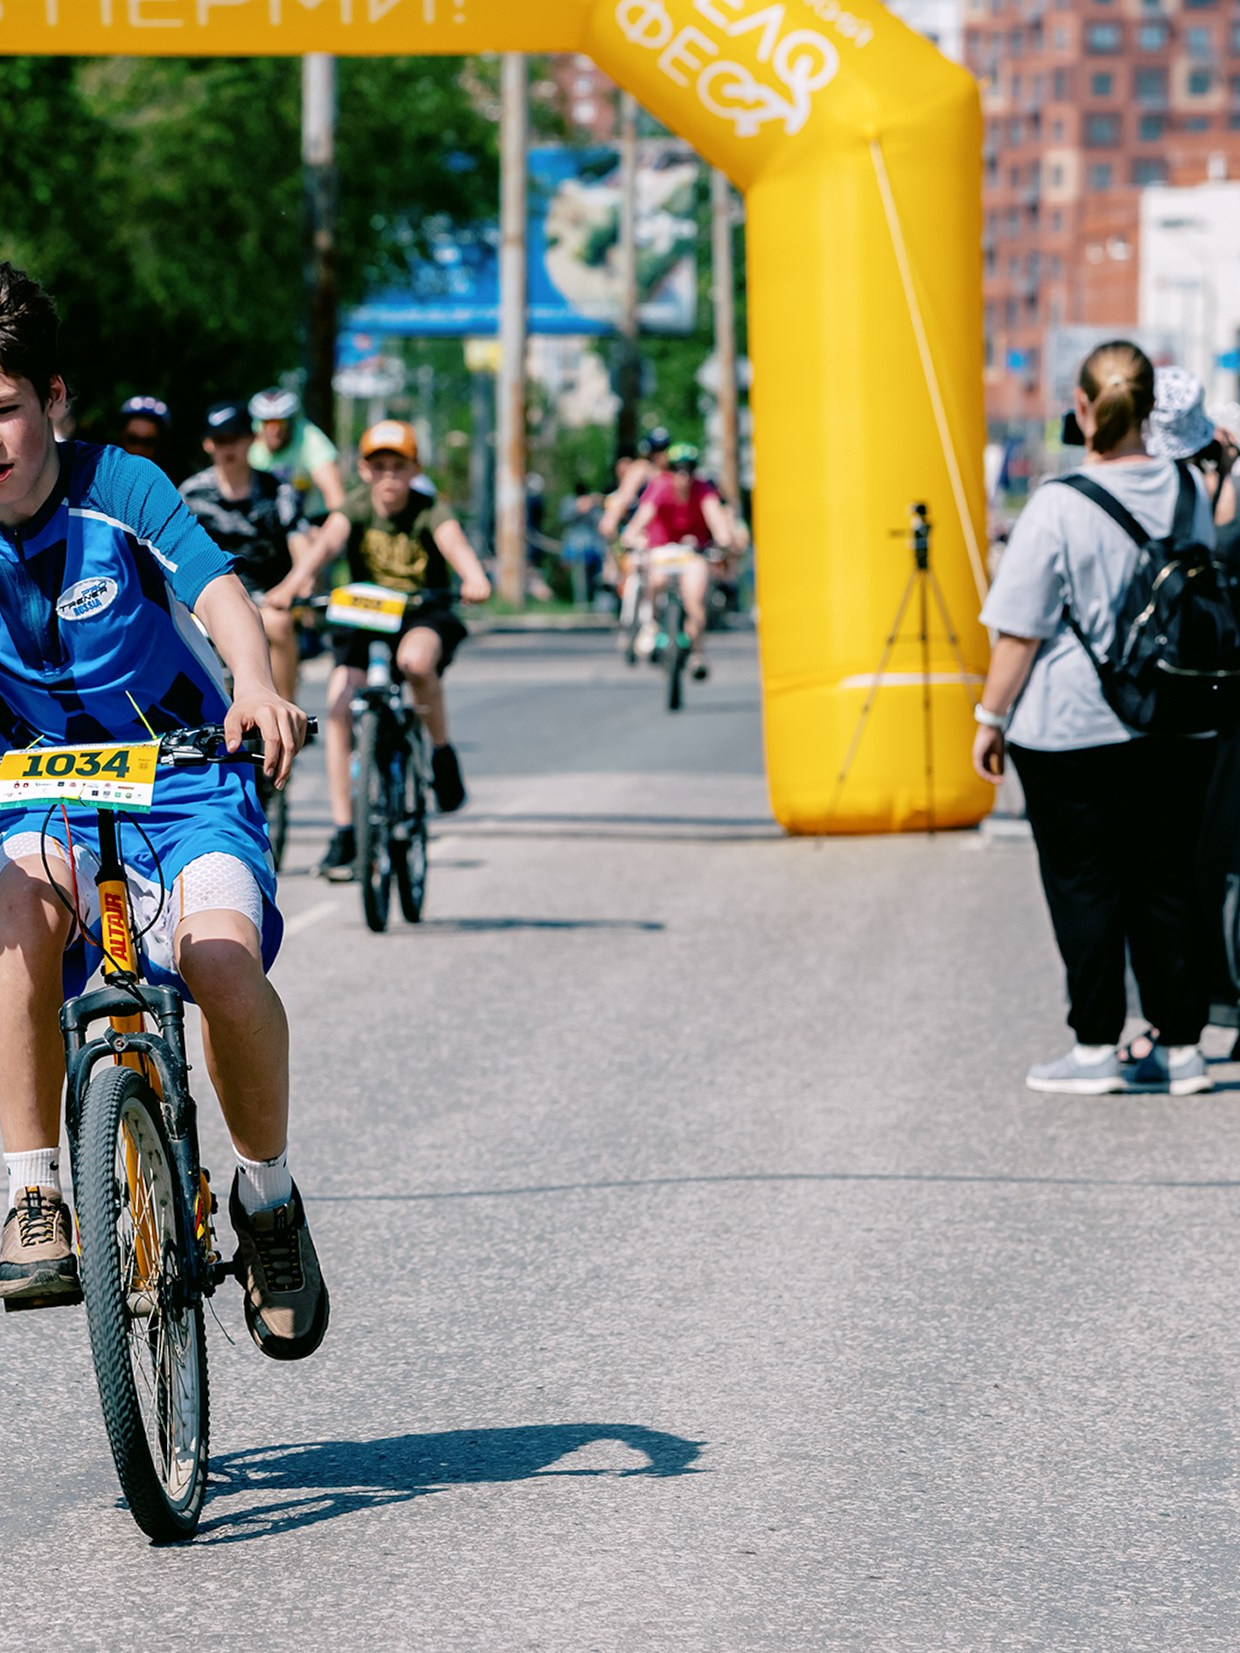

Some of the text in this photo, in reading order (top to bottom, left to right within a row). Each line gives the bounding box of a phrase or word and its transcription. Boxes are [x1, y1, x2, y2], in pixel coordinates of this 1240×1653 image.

[59, 586, 108, 612] TRENER
[73, 597, 102, 616] RUSSIA
[22, 750, 130, 779] 1034
[104, 892, 128, 962] ALTAIR
